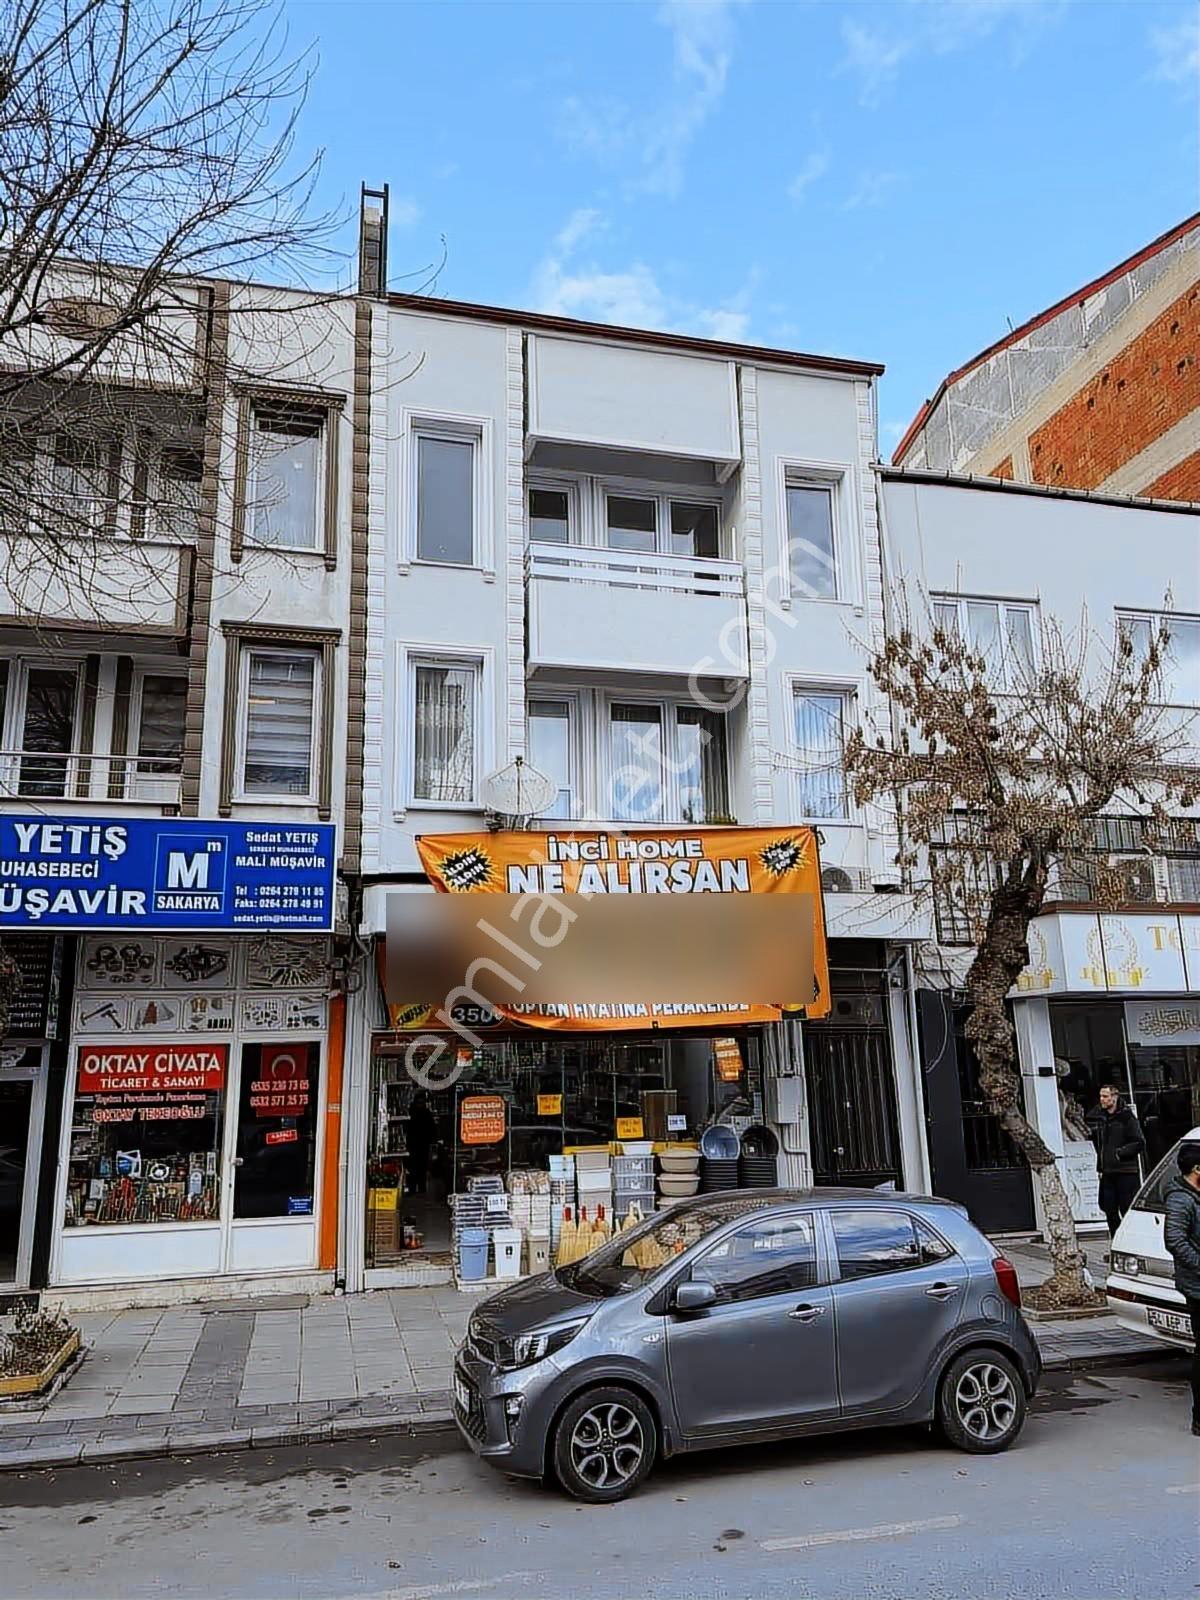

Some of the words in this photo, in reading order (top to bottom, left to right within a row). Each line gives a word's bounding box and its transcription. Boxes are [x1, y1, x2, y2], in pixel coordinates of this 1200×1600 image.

[246, 831, 281, 843] Sedat
[548, 835, 608, 861] İNCİ
[617, 838, 703, 860] HOME
[235, 854, 266, 867] MALİ
[270, 854, 326, 870] MÜŞAVİR
[507, 863, 565, 893] NE
[576, 858, 751, 893] ALIRSAN
[259, 886, 281, 896] 0264
[302, 886, 311, 897] 11
[157, 895, 220, 910] SAKARYA
[259, 898, 281, 908] 0264
[300, 899, 312, 908] 49
[84, 1053, 150, 1074] OKTAY
[154, 1048, 221, 1073] CİVATA
[100, 1074, 149, 1089] TİCARET
[151, 1077, 160, 1088] &
[163, 1073, 205, 1087] SANAYİ
[93, 1108, 137, 1123] OKTAY
